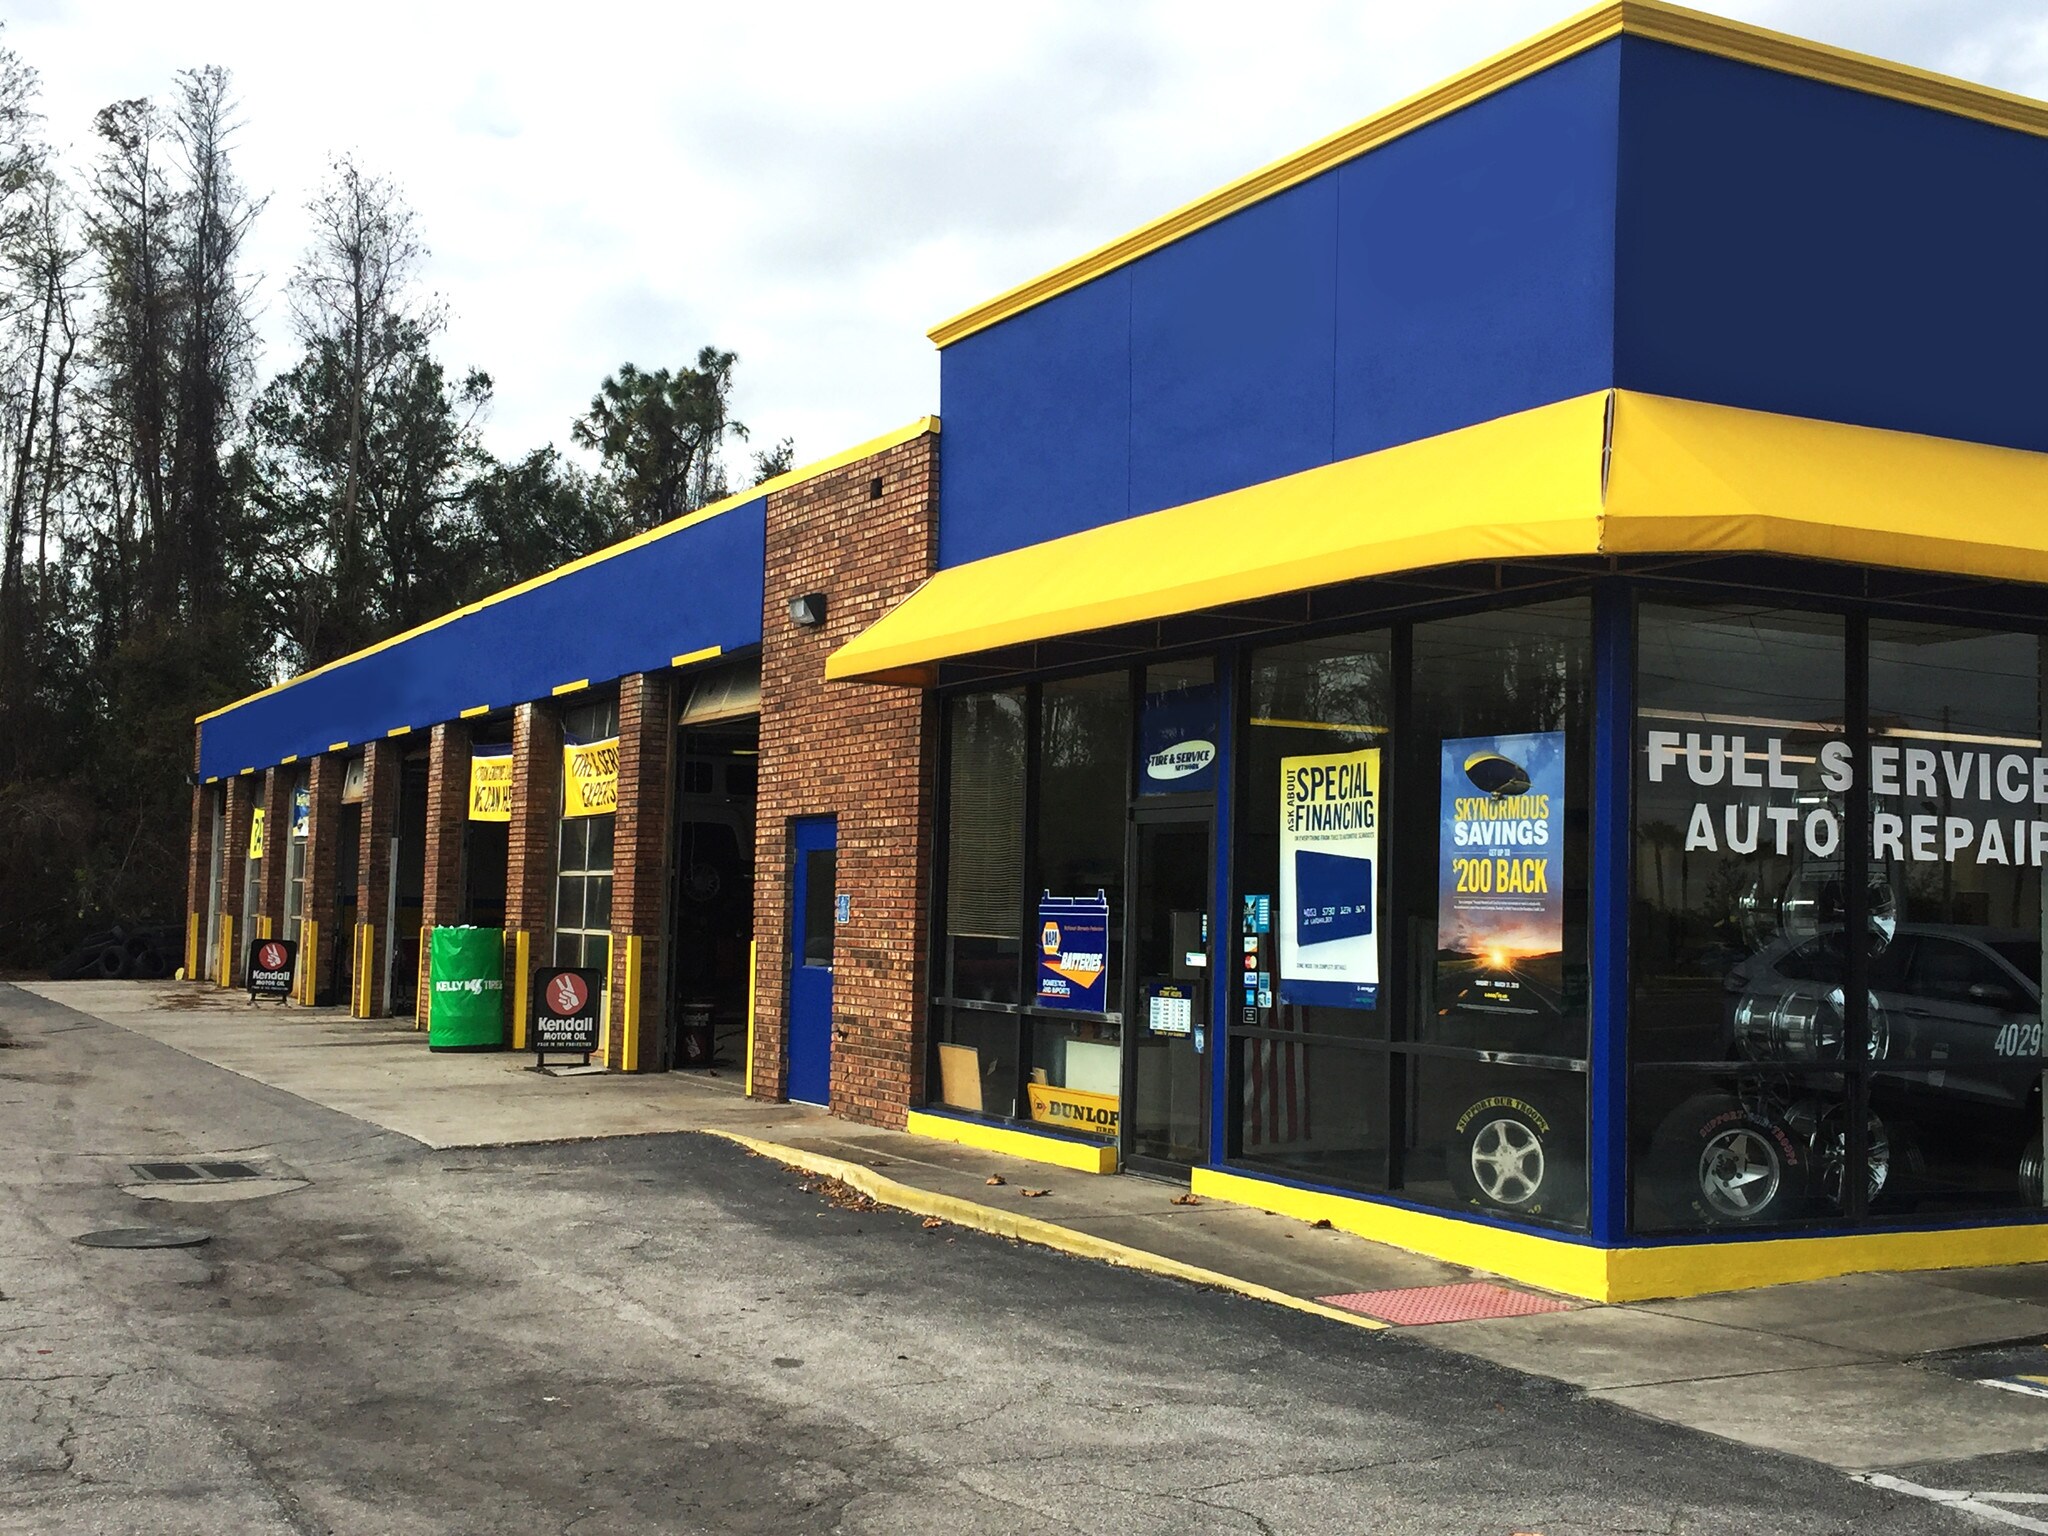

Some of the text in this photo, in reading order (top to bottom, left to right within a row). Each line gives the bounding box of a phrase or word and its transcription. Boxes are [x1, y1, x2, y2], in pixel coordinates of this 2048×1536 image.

[1151, 750, 1210, 766] TIRE & SERVICE
[1648, 730, 1798, 789] FULL
[1287, 769, 1295, 807] ABOUT
[1296, 762, 1373, 802] SPECIAL
[1295, 800, 1374, 831] FINANCING
[1454, 794, 1549, 821] SKYNORMOUS
[1454, 820, 1549, 846] SAVINGS
[1685, 803, 1840, 858] AUTO
[1452, 858, 1548, 893] $200 BACK
[252, 970, 290, 980] Kendall
[1060, 952, 1103, 972] BATTERIES
[436, 981, 464, 991] KELLY
[538, 1017, 593, 1031] Kendall
[543, 1032, 586, 1040] MOTOR OIL
[1994, 1023, 2041, 1056] 4029
[1049, 1101, 1119, 1126] DUNLOP
[1459, 1097, 1547, 1129] SUPPORT OUR TROOPS
